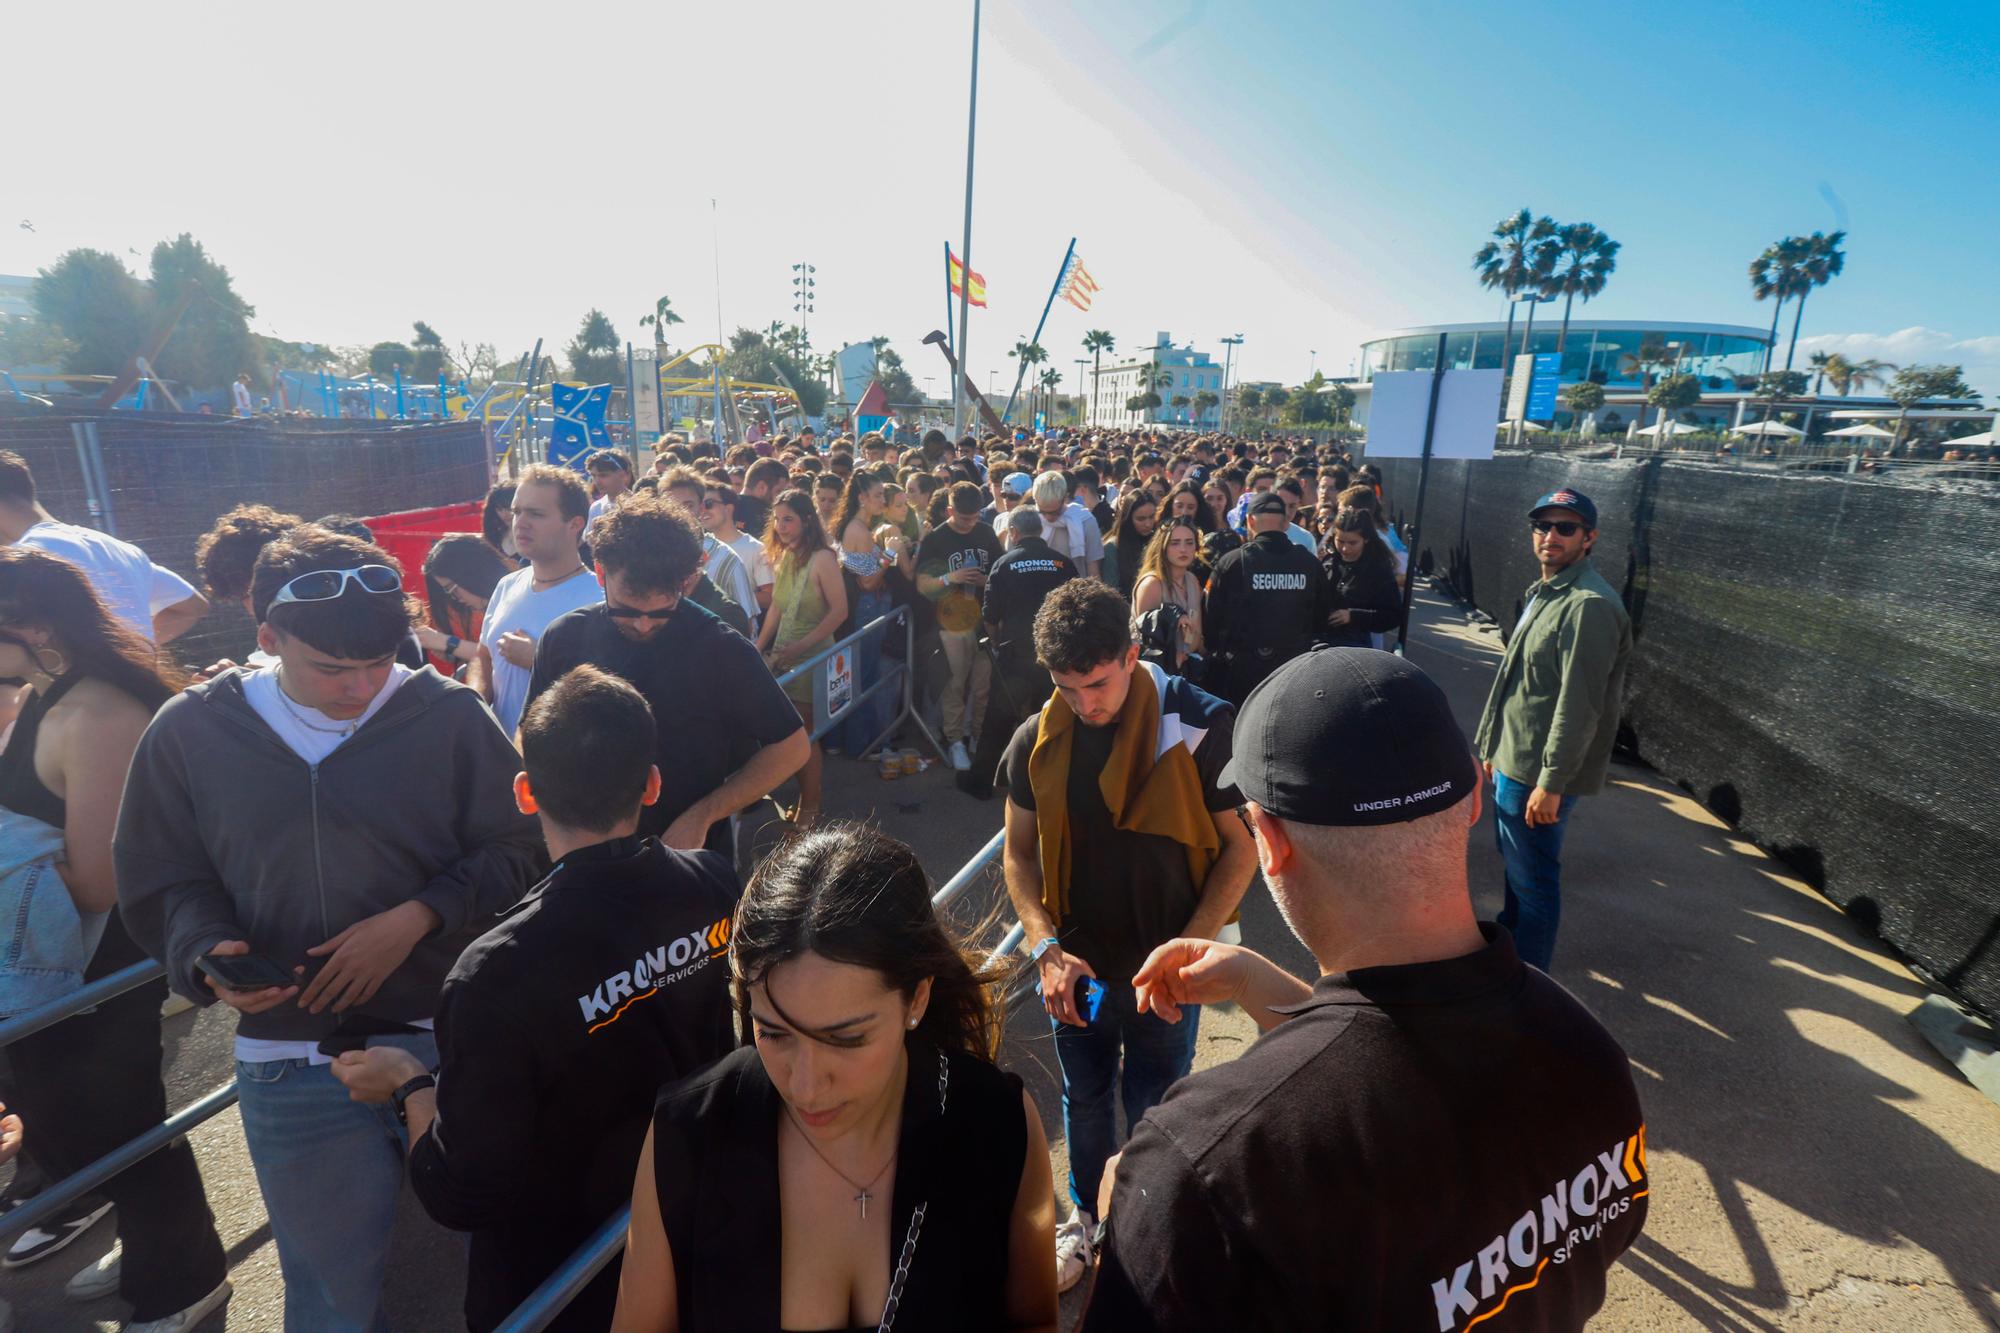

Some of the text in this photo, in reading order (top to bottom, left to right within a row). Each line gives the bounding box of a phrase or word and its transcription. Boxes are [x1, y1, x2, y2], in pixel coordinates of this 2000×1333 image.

[1009, 559, 1054, 571] KRONOX
[1018, 566, 1058, 574] SEGURIDAD
[1252, 573, 1307, 590] SEGURIDAD
[1353, 781, 1453, 812] UNDER ARMOUR
[577, 925, 710, 1023] KRONOX
[1431, 1141, 1629, 1333] KRONOX
